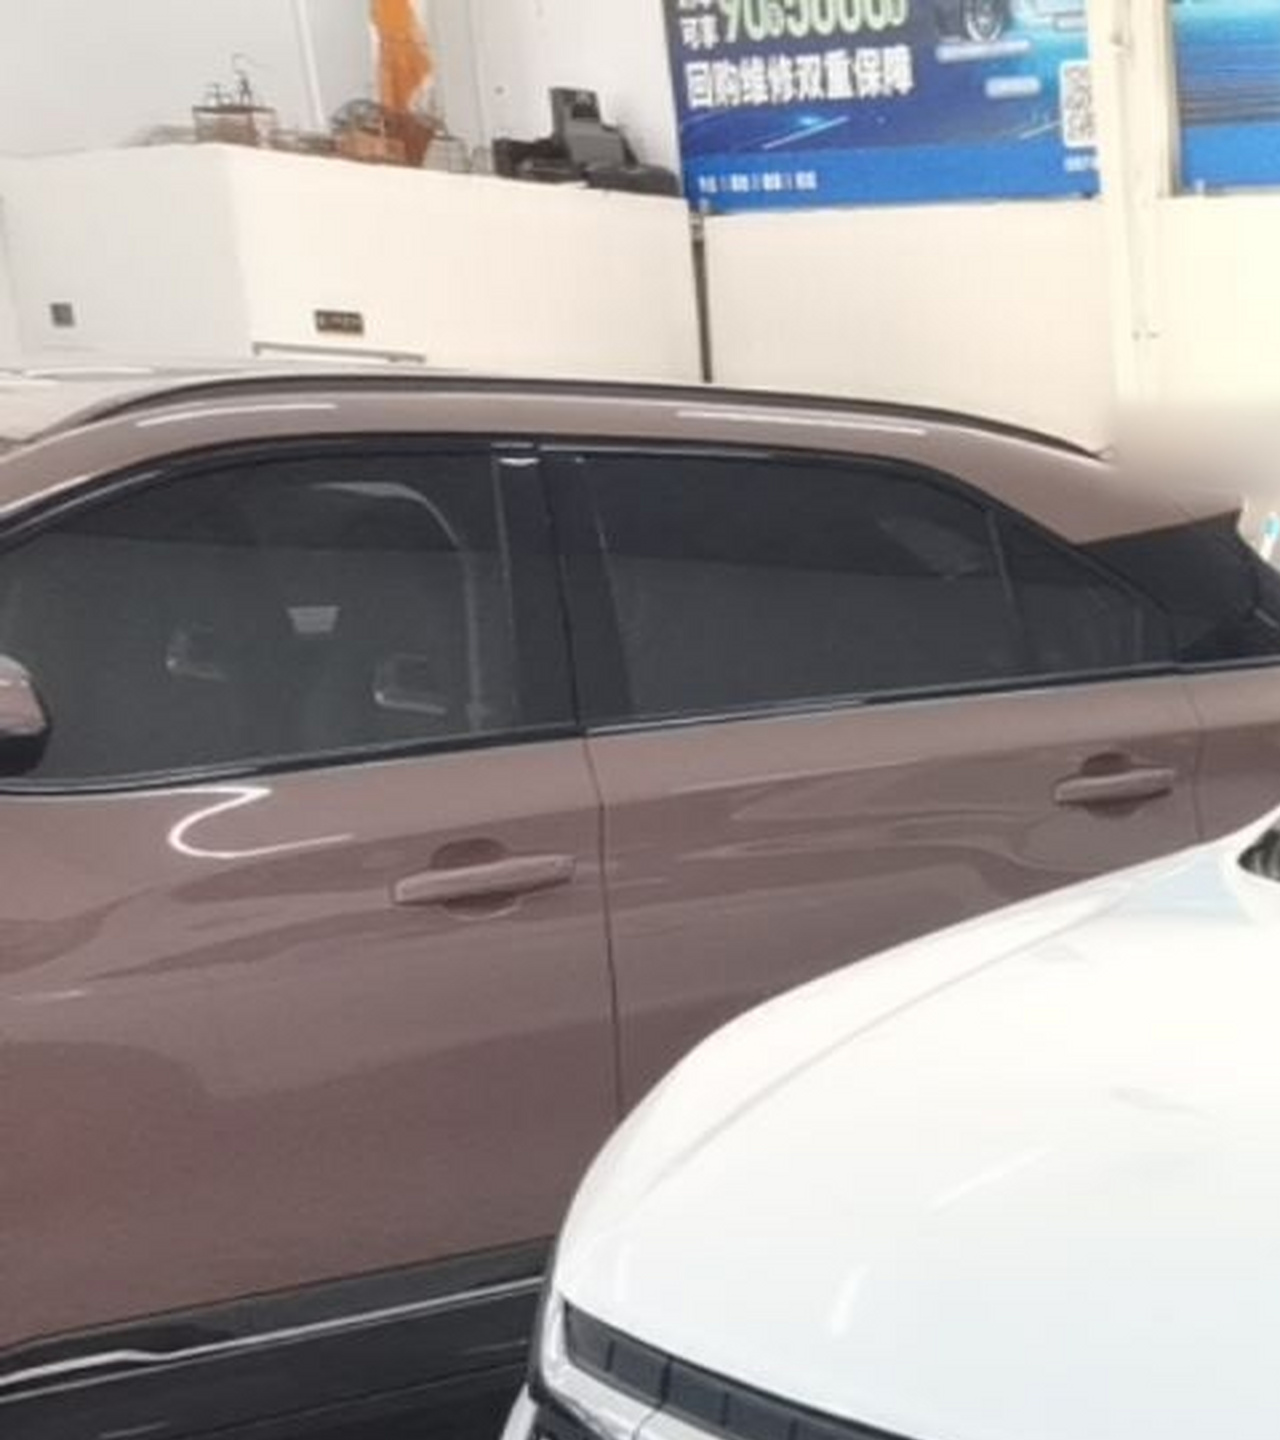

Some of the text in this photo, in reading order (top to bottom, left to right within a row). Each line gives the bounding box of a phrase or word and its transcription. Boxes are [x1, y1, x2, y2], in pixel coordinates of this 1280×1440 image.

[684, 43, 914, 110] 回购维修双重保障
